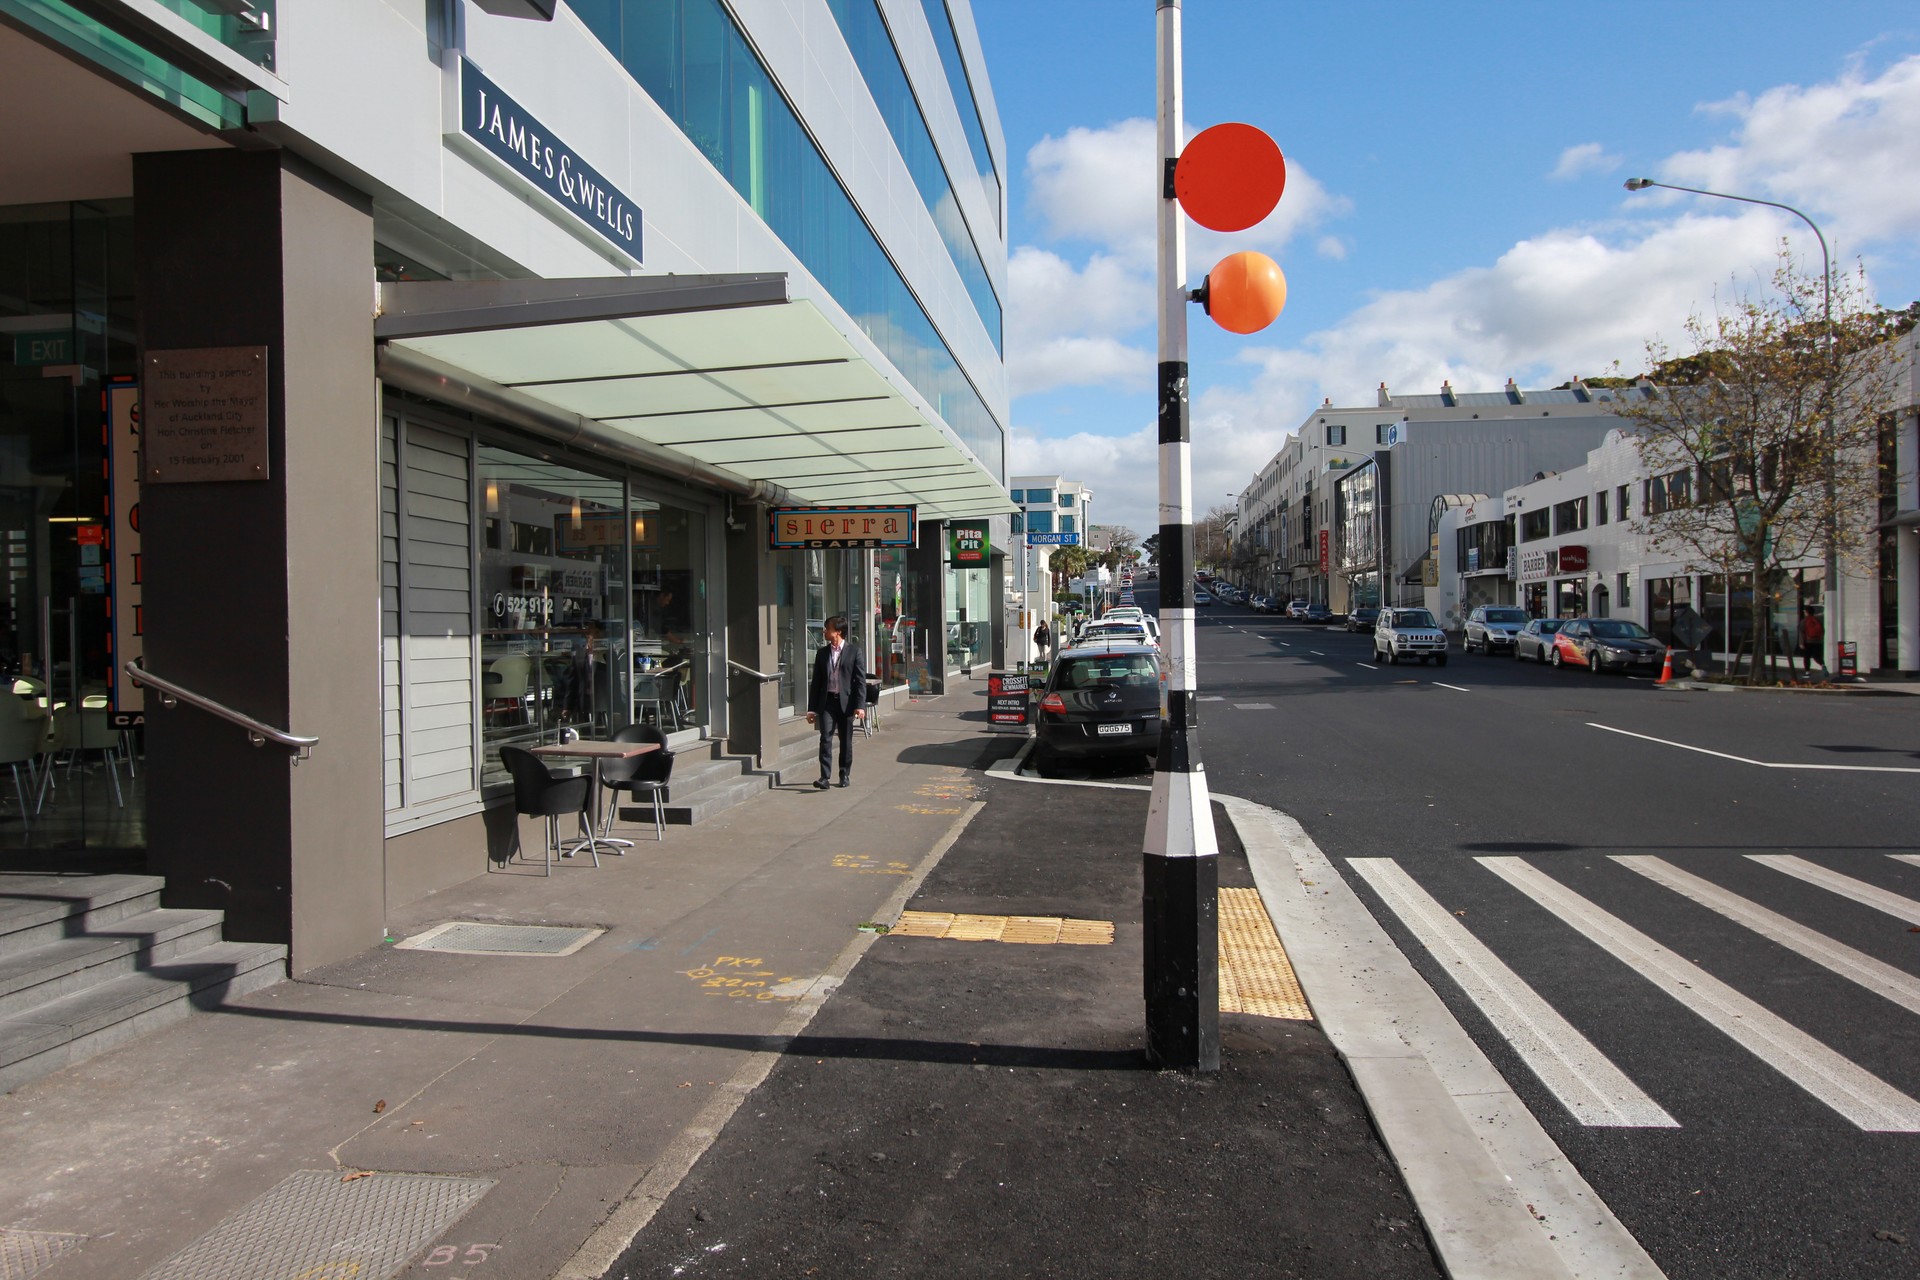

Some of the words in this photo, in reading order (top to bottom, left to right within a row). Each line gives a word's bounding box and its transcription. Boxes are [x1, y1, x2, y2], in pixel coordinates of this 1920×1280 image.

[478, 89, 555, 180] JAMES
[578, 172, 634, 242] WELLS
[31, 339, 67, 361] EXIT
[159, 370, 176, 380] This
[180, 368, 216, 380] building
[199, 384, 211, 394] by
[154, 399, 169, 409] Her
[172, 397, 209, 409] Worship
[212, 397, 226, 407] the
[230, 396, 258, 408] Mayor
[168, 413, 178, 423] of
[181, 412, 223, 423] Auckland
[226, 411, 243, 423] City
[158, 428, 176, 438] Hon
[178, 426, 219, 438] Christine
[220, 425, 256, 436] Fletcher
[200, 441, 213, 450] on
[182, 455, 221, 466] February
[223, 453, 246, 464] 2001
[786, 517, 899, 536] sierra
[956, 529, 983, 540] Pita
[1031, 533, 1061, 544] MORGAN
[1064, 533, 1073, 543] ST
[810, 540, 876, 549] CAFE
[960, 540, 979, 550] Pit
[1523, 557, 1546, 573] BARBER
[507, 596, 528, 613] 522
[529, 597, 554, 614] 9172
[1003, 676, 1028, 685] CROSSFIT
[1098, 724, 1130, 733] GQG675
